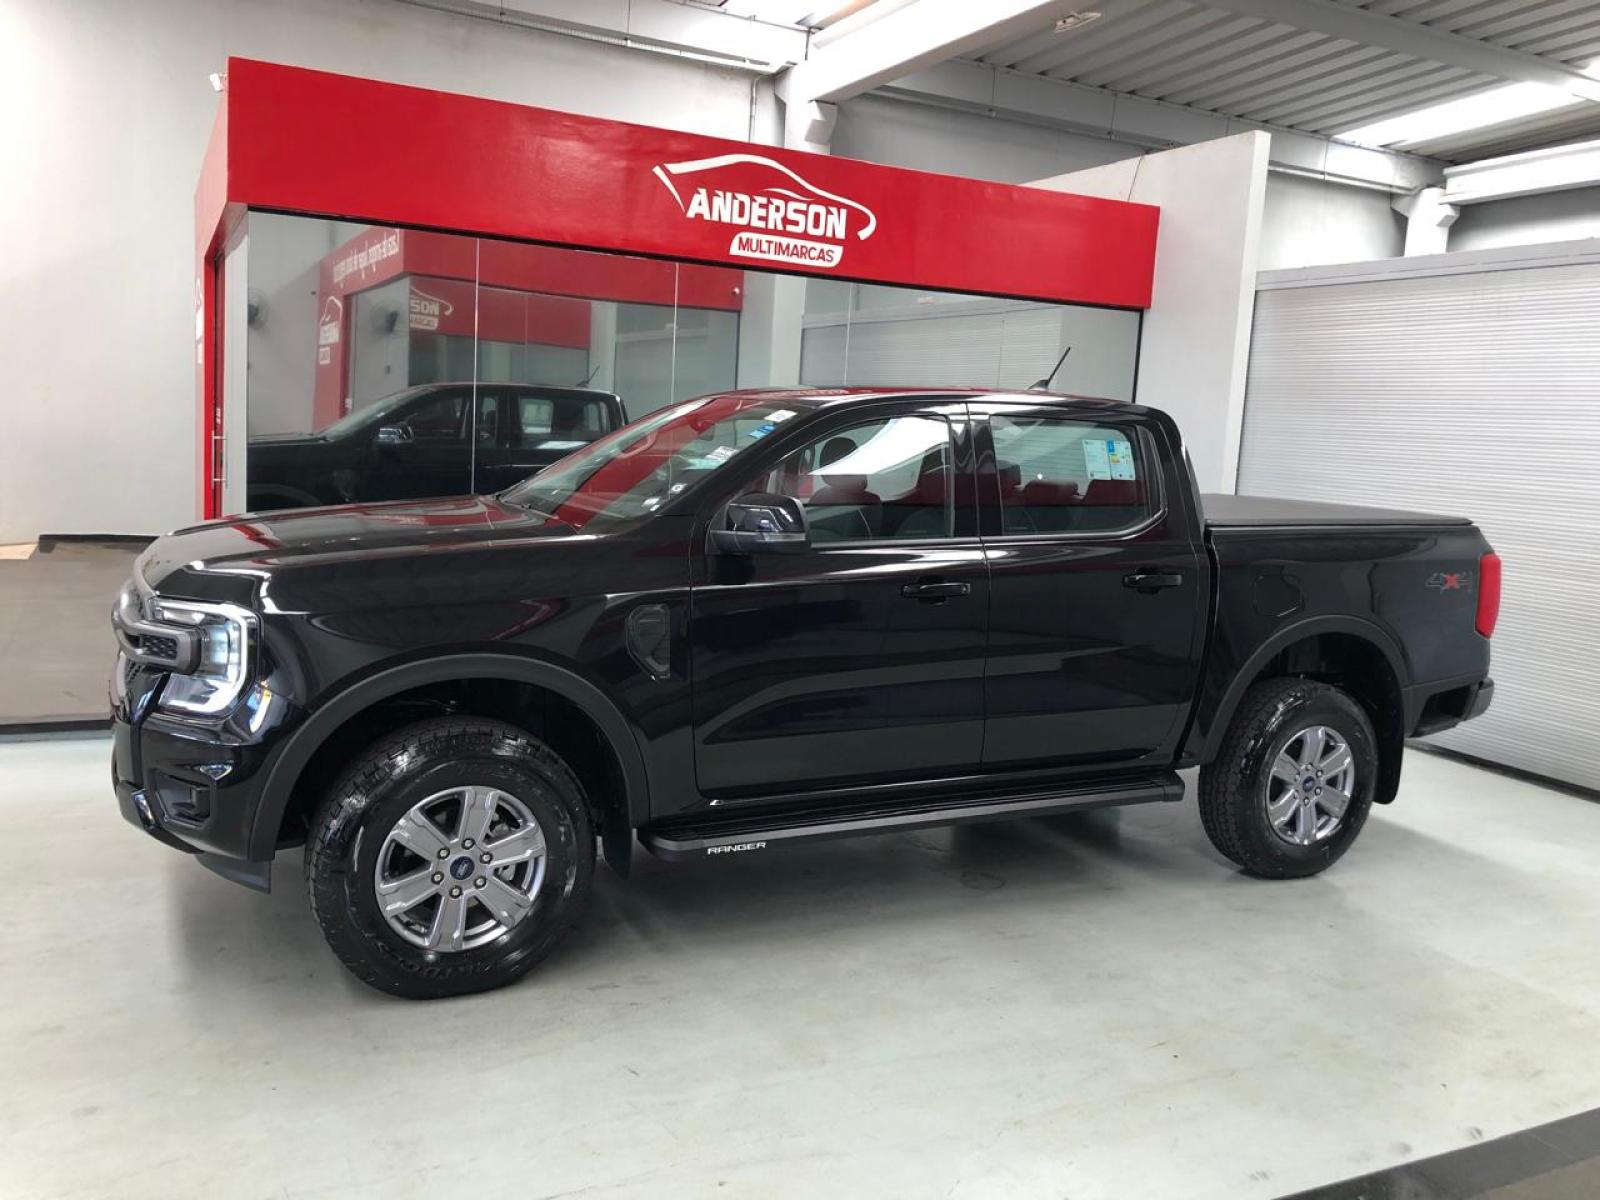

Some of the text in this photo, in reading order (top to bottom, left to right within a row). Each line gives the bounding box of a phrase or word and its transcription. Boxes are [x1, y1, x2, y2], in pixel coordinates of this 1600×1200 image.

[686, 187, 847, 239] ANDERSON
[737, 236, 834, 263] MULTIMARCAS
[707, 841, 767, 855] RANGER
